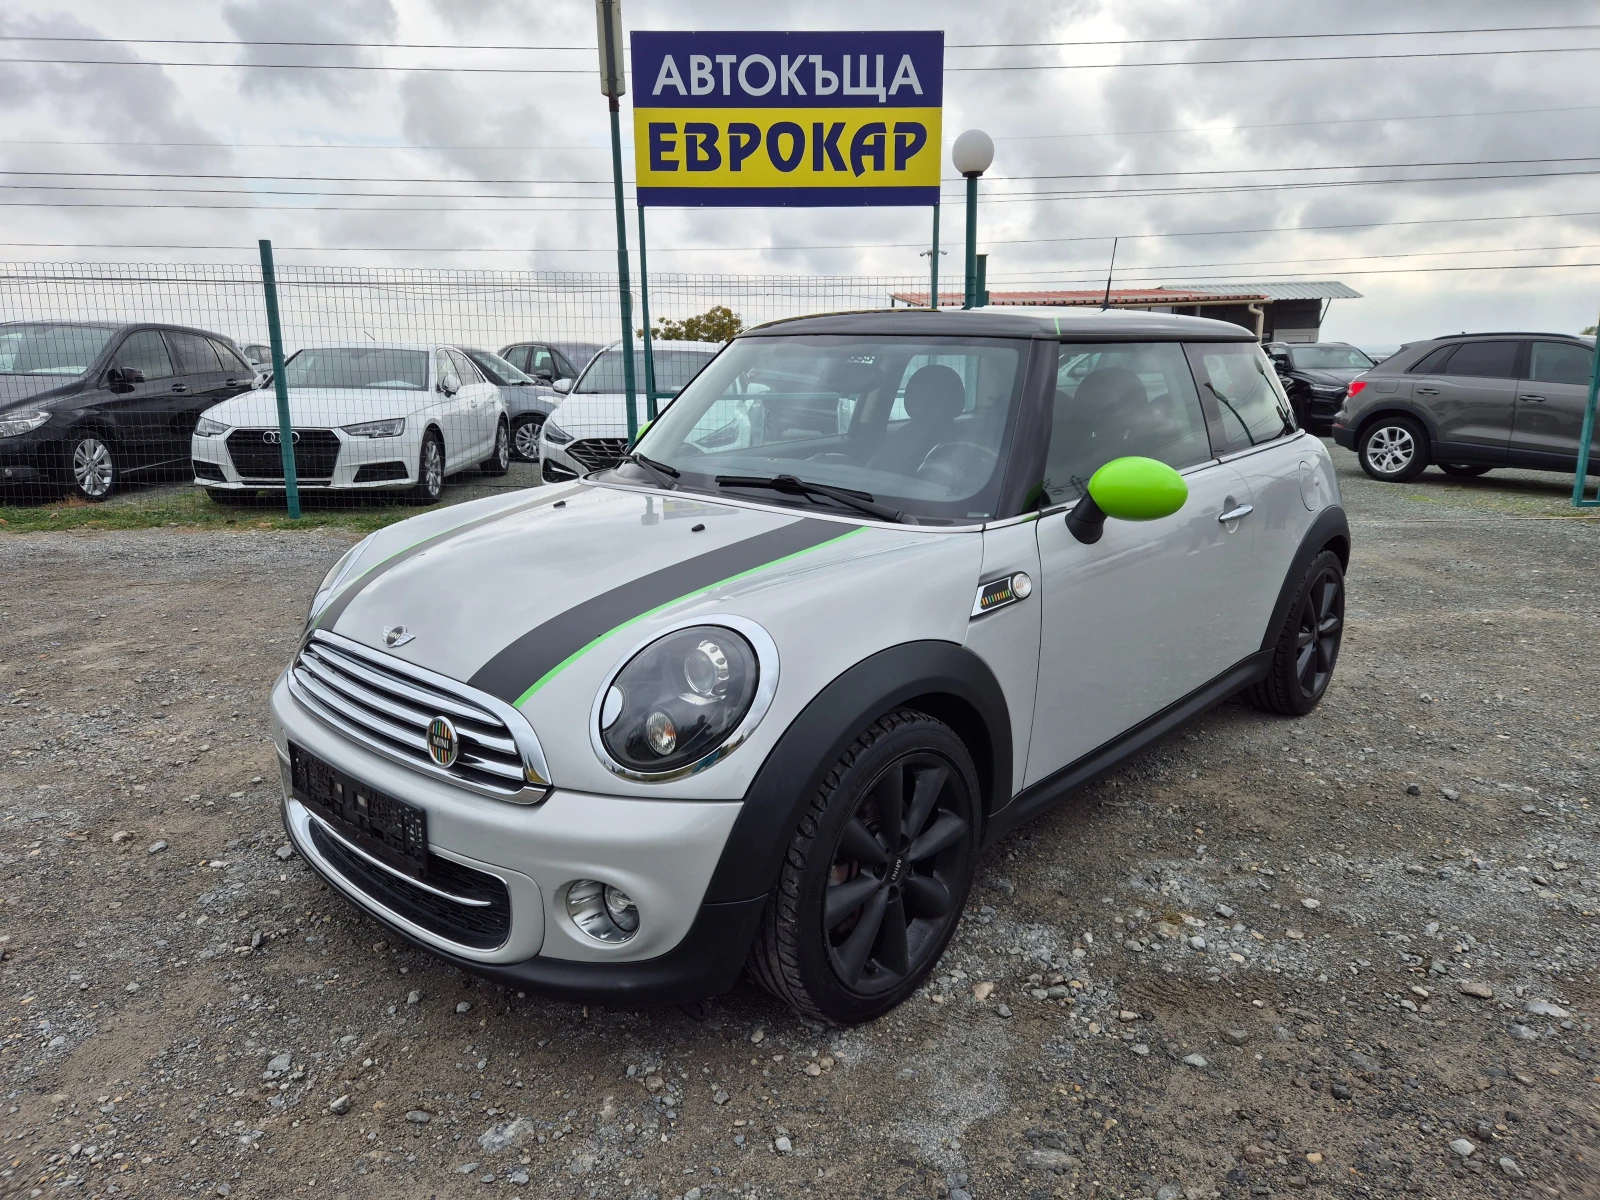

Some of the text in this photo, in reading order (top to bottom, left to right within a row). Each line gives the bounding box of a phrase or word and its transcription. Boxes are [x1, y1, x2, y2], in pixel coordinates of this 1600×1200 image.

[652, 54, 923, 103] АВТОКЪЩА
[648, 121, 927, 178] ЕВРОКАР
[433, 735, 449, 749] MINI
[891, 859, 902, 881] MINI
